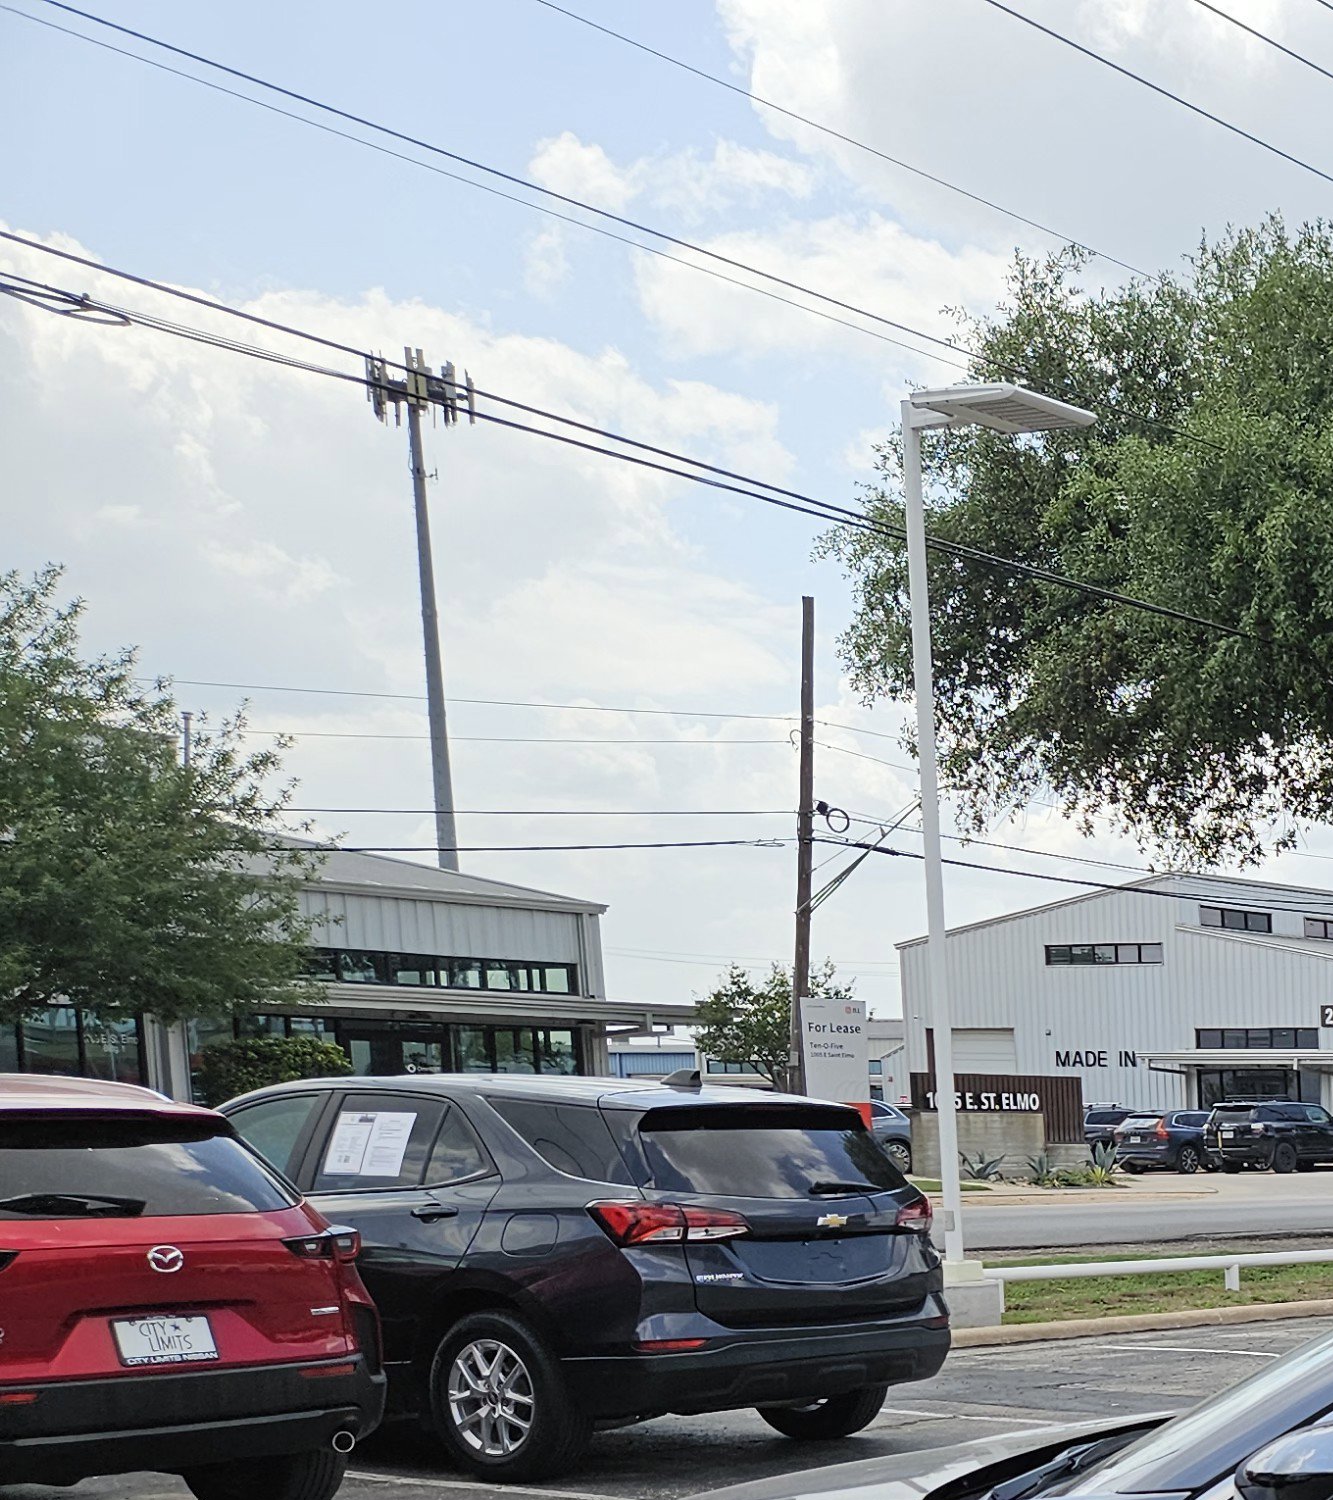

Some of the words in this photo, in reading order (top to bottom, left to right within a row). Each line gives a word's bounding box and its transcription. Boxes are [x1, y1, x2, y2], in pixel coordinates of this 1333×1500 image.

[1325, 1007, 1333, 1025] 2
[808, 1022, 827, 1033] For
[829, 1022, 861, 1034] Lease
[1055, 1050, 1108, 1068] MADE
[1119, 1050, 1137, 1068] IN
[965, 1092, 978, 1109] E.
[981, 1093, 1000, 1110] ST.
[1001, 1093, 1039, 1110] ELMO
[139, 1321, 166, 1337] CITY
[149, 1335, 193, 1352] LIMITS
